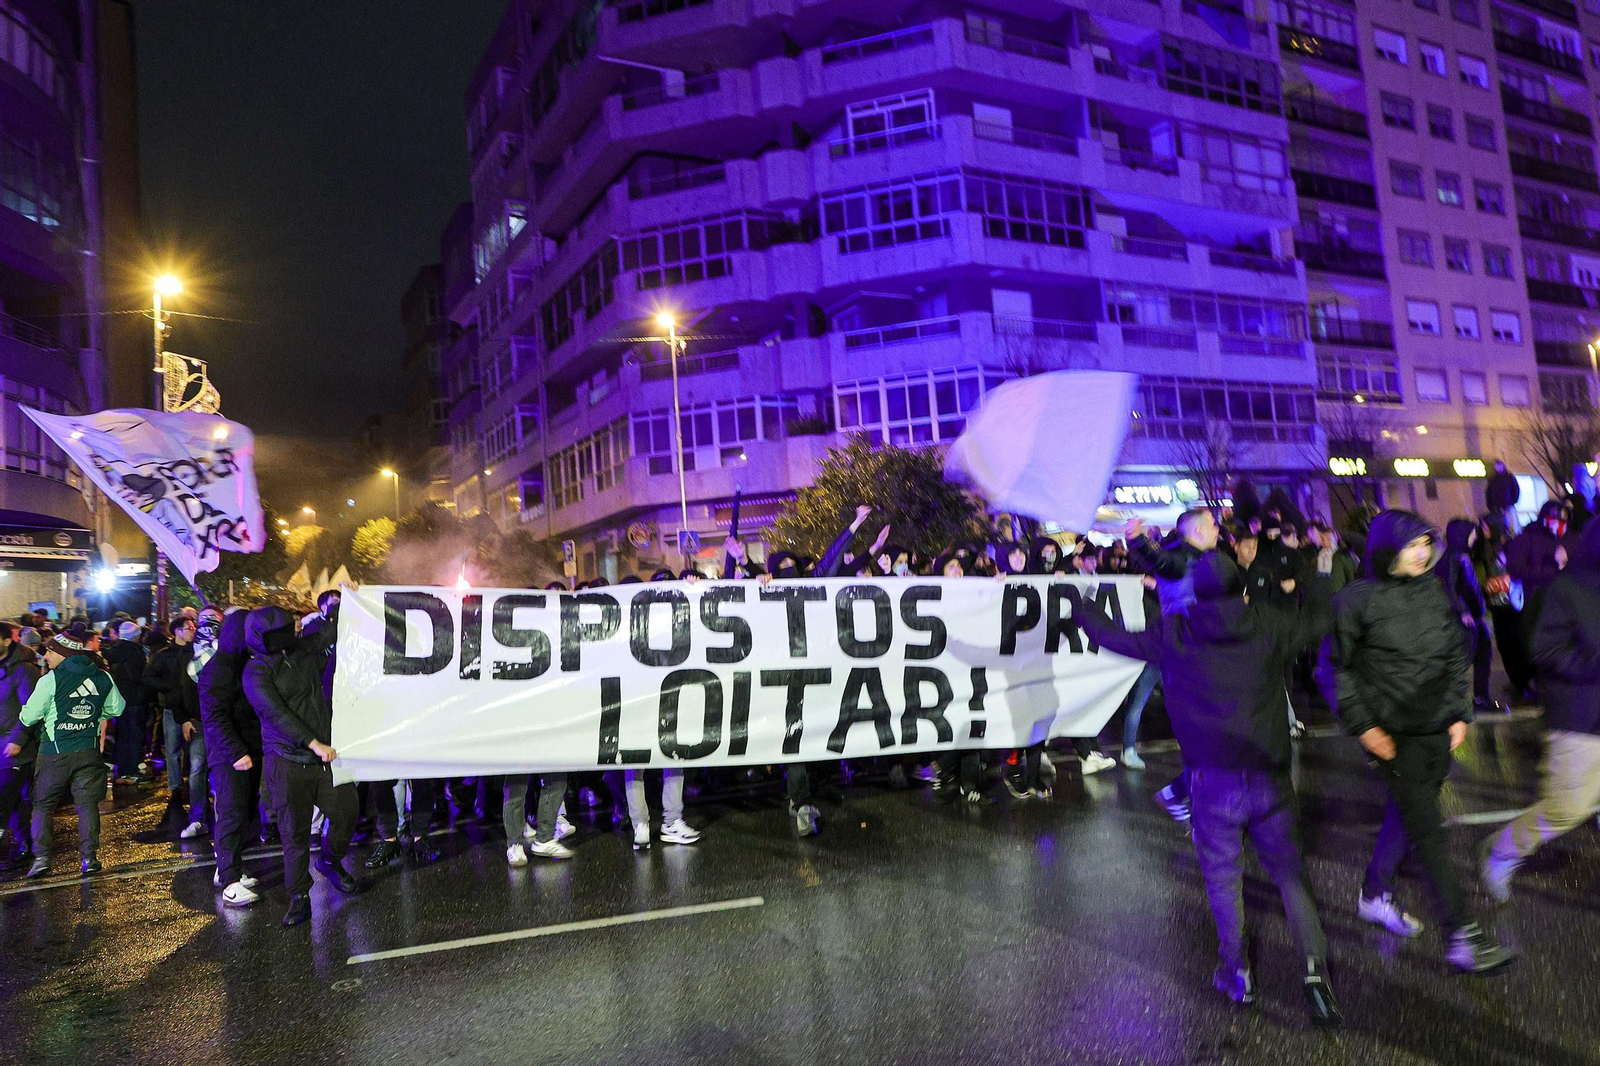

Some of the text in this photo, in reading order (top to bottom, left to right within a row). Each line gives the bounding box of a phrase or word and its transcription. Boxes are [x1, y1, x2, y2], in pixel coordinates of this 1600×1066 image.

[383, 583, 1126, 680] DISPOSTOS PRA
[597, 666, 988, 764] LOITAR!
